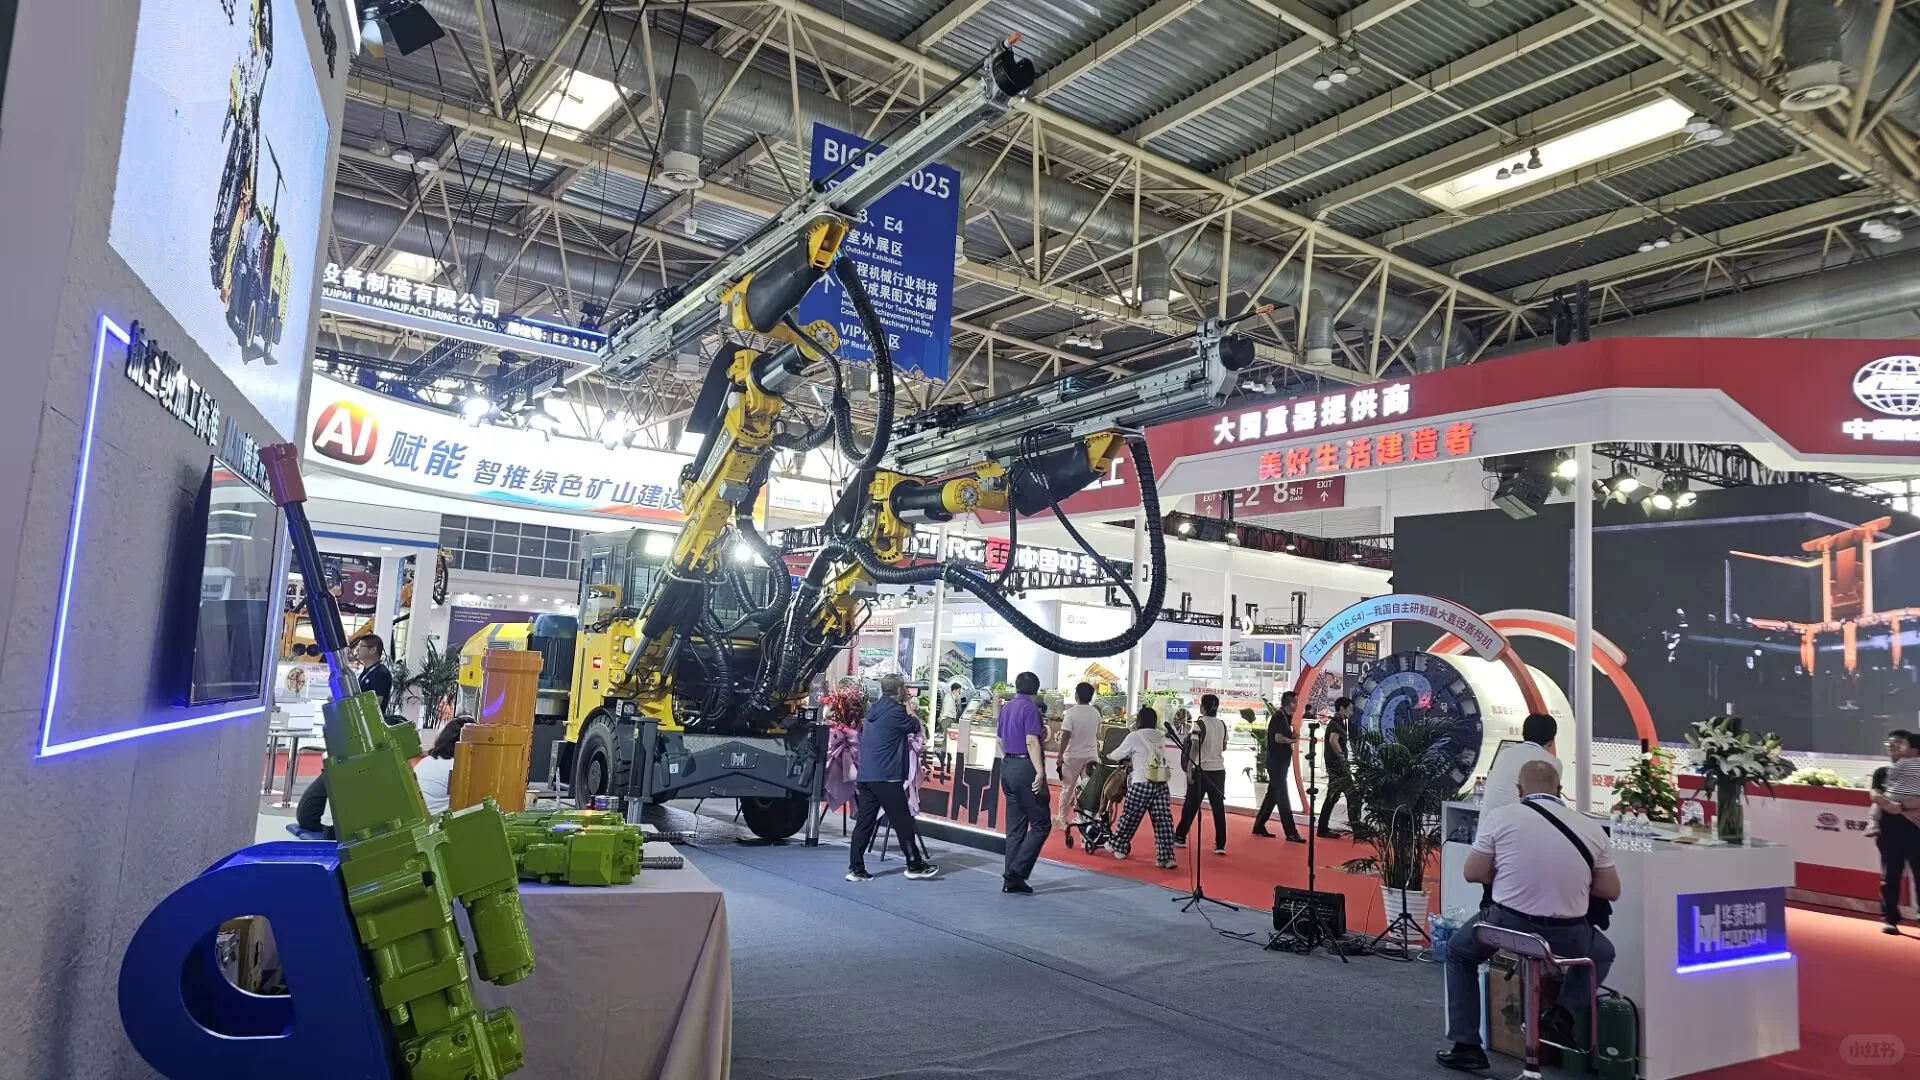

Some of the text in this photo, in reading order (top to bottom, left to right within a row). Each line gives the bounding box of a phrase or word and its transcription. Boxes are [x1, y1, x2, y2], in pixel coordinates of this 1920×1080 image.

[824, 138, 950, 199] BIC 025
[845, 245, 902, 266] Outdoor Exhibition
[847, 230, 904, 257] 室外展区
[851, 261, 938, 297] 程机械行业科技
[861, 279, 937, 312] 成果图文长廊
[373, 297, 457, 323] MANUFACTURING
[1213, 383, 1411, 446] 大国重器提供商
[314, 407, 371, 457] AI
[1259, 423, 1474, 481] 美好生活建造者
[383, 430, 684, 511] 赋能 智推绿色矿山建设
[1316, 479, 1333, 489] EXIT
[1203, 493, 1216, 502] EXIT
[353, 580, 367, 596] 9
